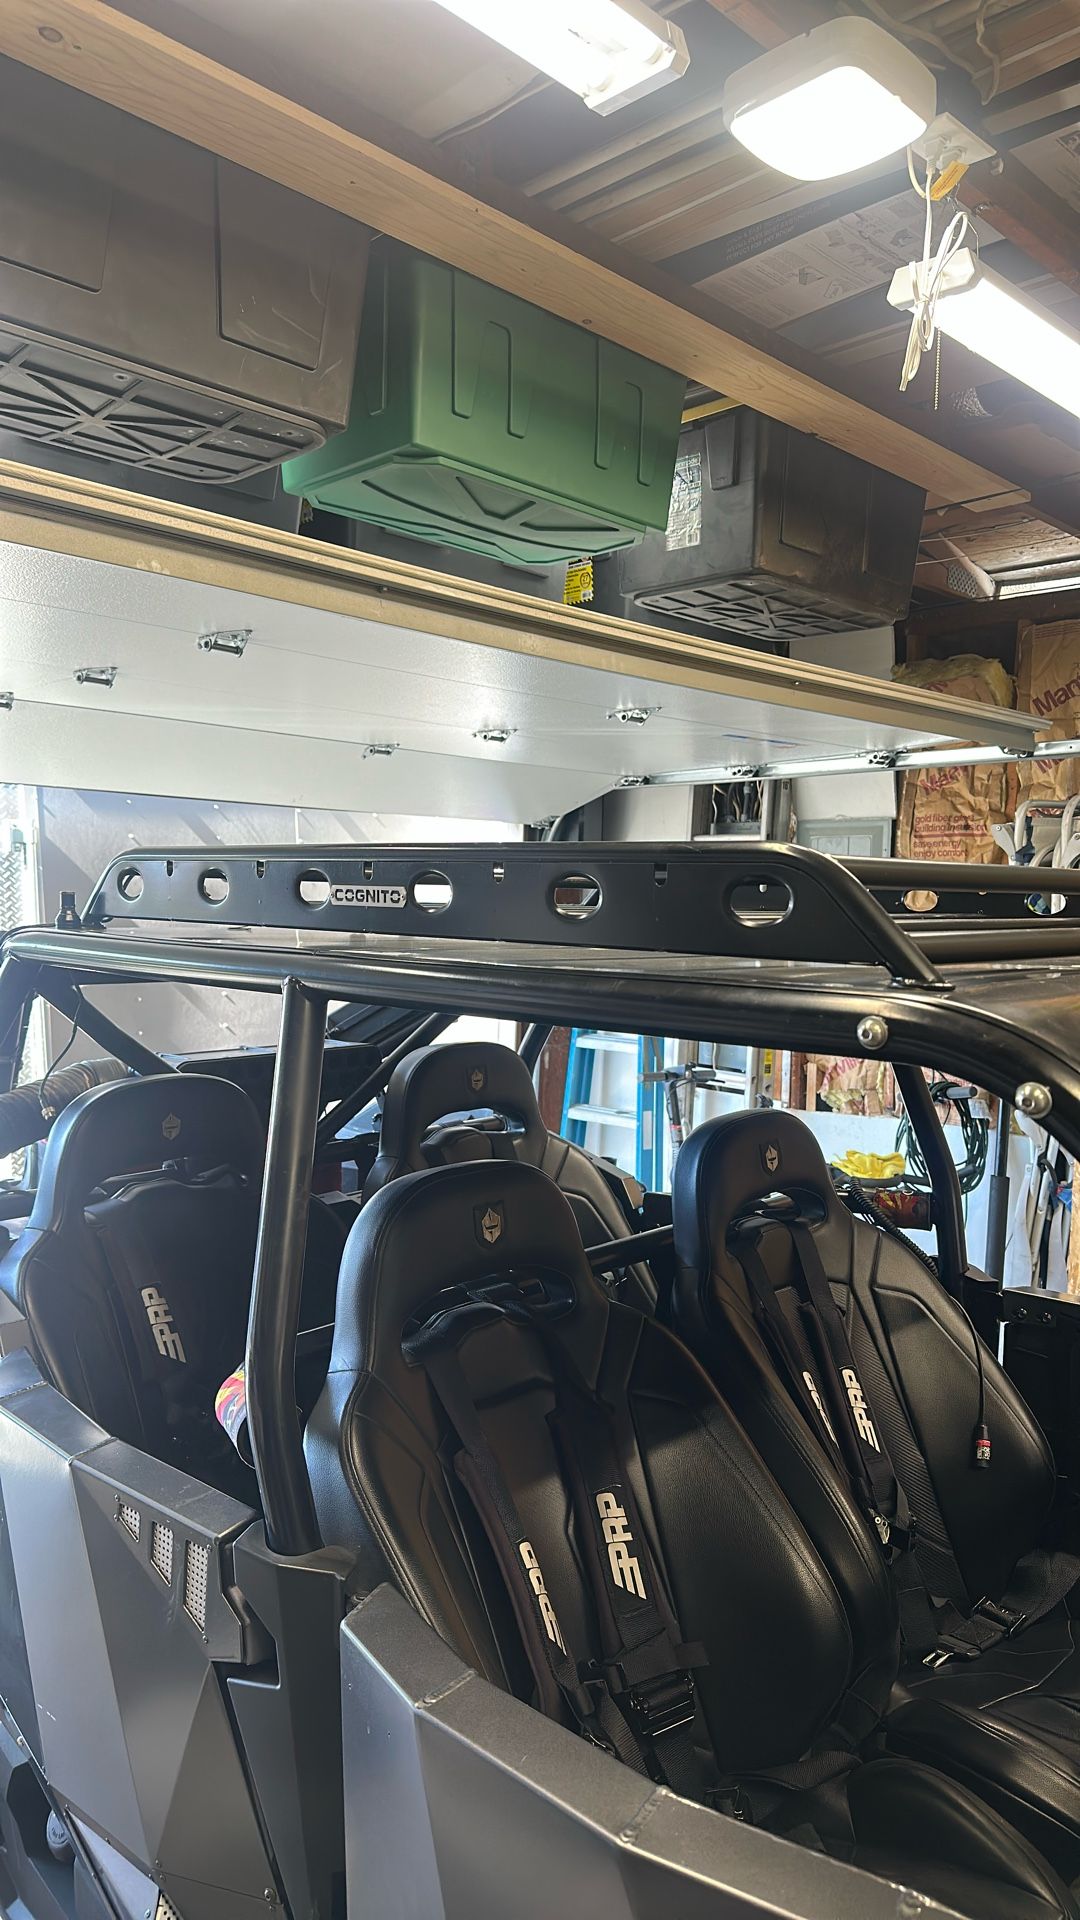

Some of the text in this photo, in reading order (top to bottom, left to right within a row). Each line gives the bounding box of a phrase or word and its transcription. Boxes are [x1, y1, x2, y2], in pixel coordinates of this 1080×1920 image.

[916, 814, 931, 825] gold
[932, 813, 952, 823] fiber
[335, 888, 401, 904] COGNITO
[141, 1287, 187, 1364] PRP
[842, 1369, 881, 1454] PRP
[595, 1492, 647, 1600] PRP
